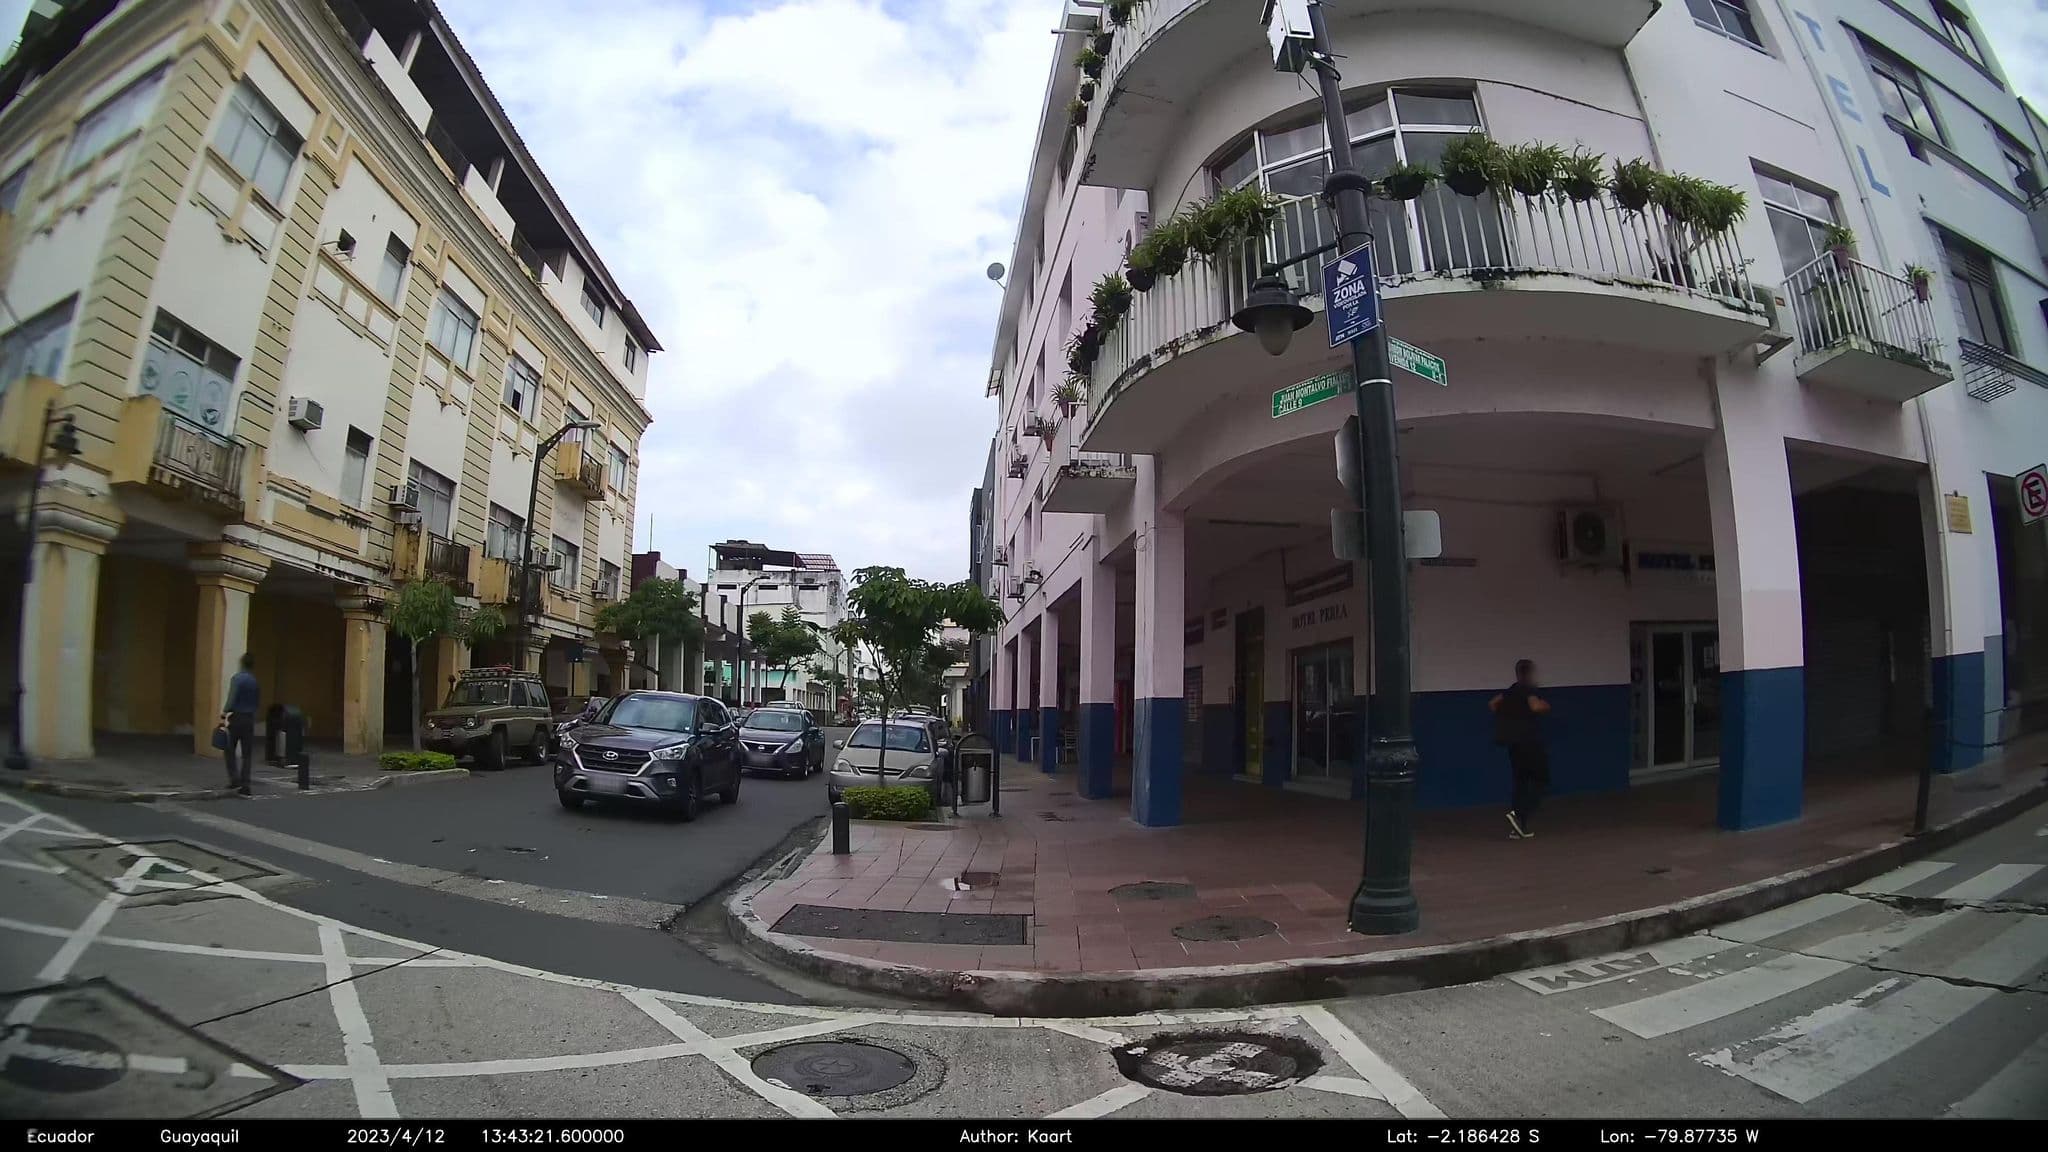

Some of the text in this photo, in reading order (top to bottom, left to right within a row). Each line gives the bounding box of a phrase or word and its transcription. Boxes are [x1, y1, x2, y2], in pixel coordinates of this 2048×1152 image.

[1333, 280, 1365, 303] ZONA
[1280, 389, 1295, 402] JUAN
[1295, 380, 1326, 399] MONTALVO
[1279, 399, 1297, 413] CALLE
